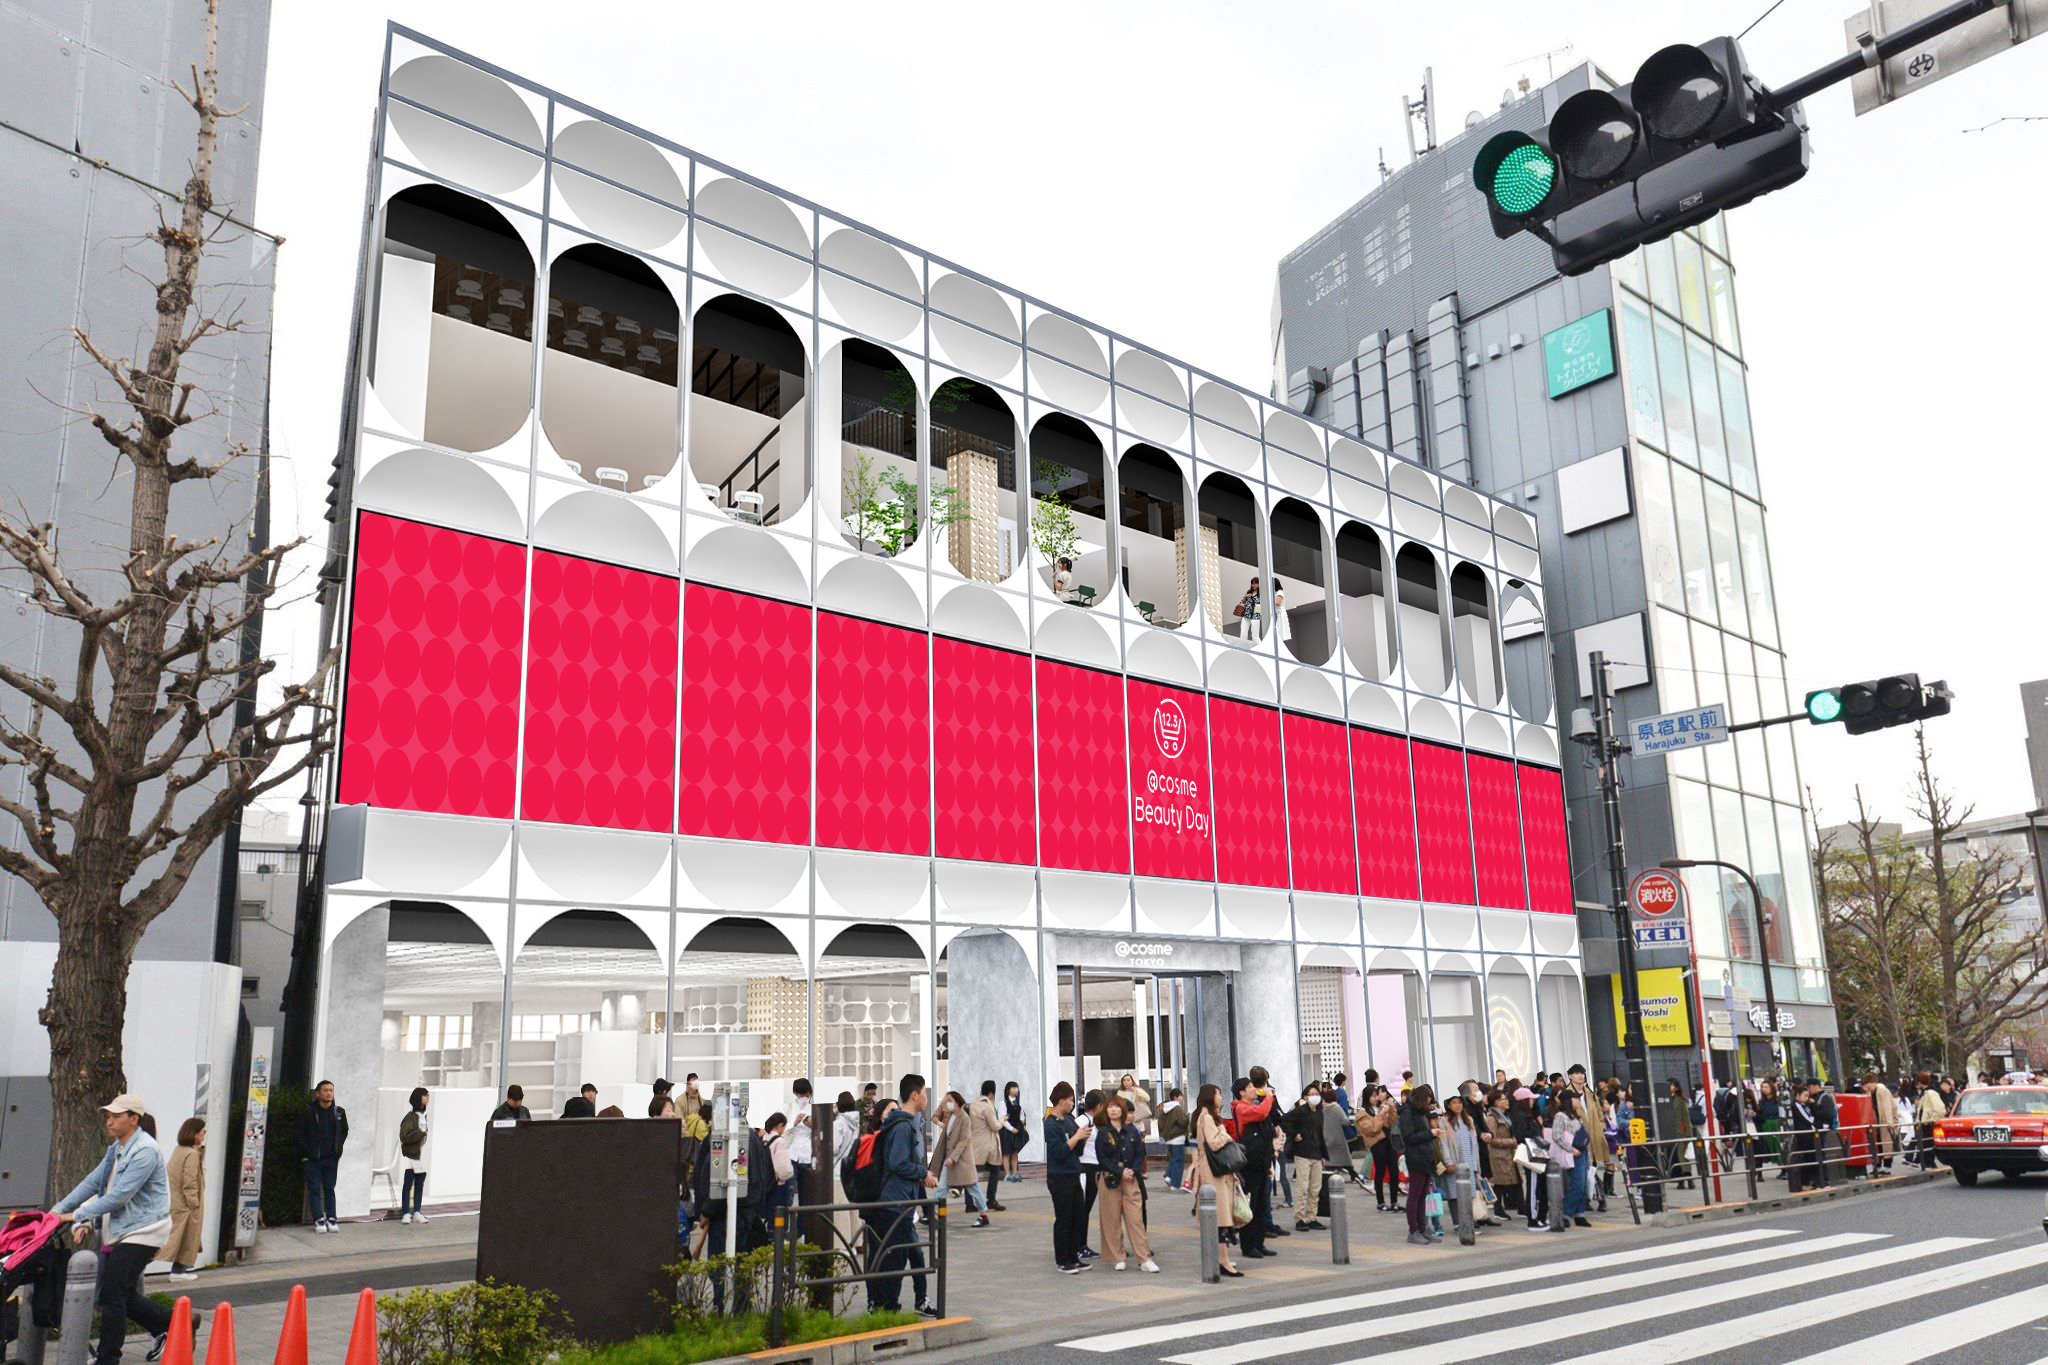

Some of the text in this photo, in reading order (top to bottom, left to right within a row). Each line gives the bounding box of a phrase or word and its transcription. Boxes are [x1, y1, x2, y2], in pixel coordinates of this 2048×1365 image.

[1162, 712, 1178, 728] 12.3
[1637, 710, 1718, 741] 原宿駅前
[1644, 731, 1714, 751] Harajuku Sta.
[1147, 769, 1198, 798] @cosme
[1135, 796, 1209, 838] Beauty Day
[1640, 886, 1675, 904] 消火栓
[1640, 928, 1681, 941] KEN
[1115, 941, 1174, 957] @cosme
[1129, 958, 1165, 966] TOKYO
